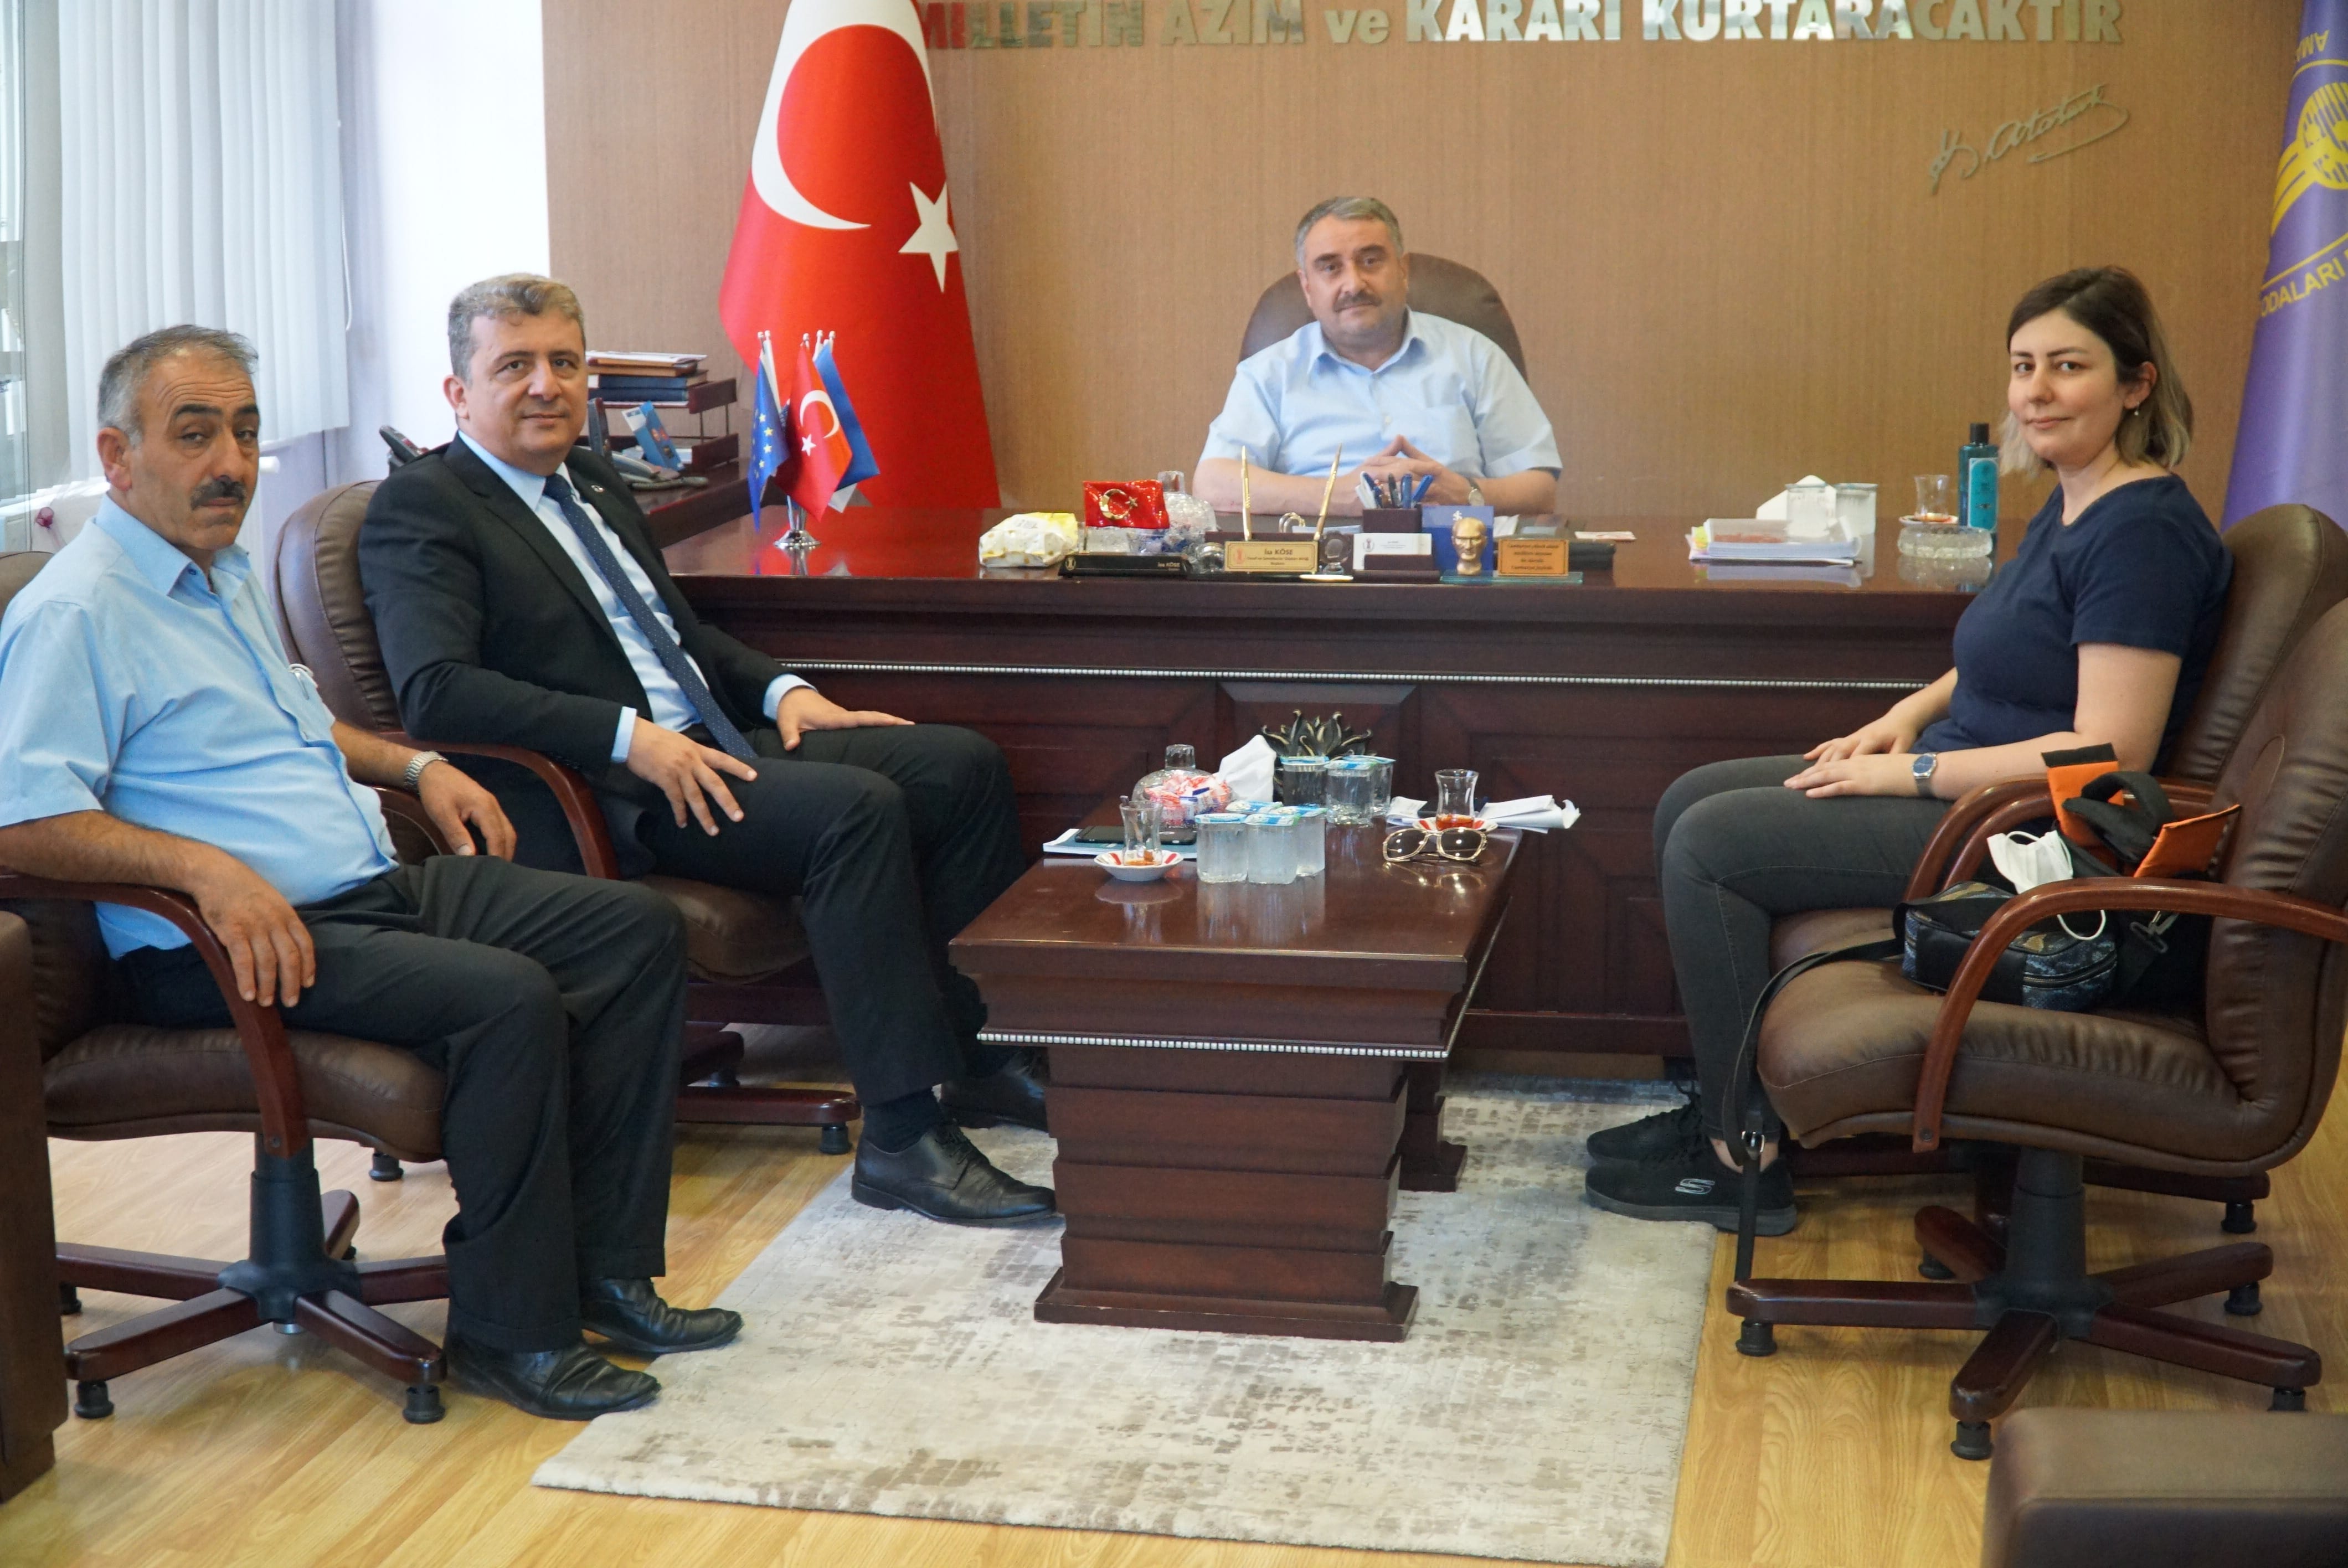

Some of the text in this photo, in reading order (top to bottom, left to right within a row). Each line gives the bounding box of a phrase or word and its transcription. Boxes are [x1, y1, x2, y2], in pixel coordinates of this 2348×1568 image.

[1324, 9, 1389, 44] ve
[1406, 0, 1620, 42] KARARI
[1642, 0, 2123, 43] KURTARACAKTIR
